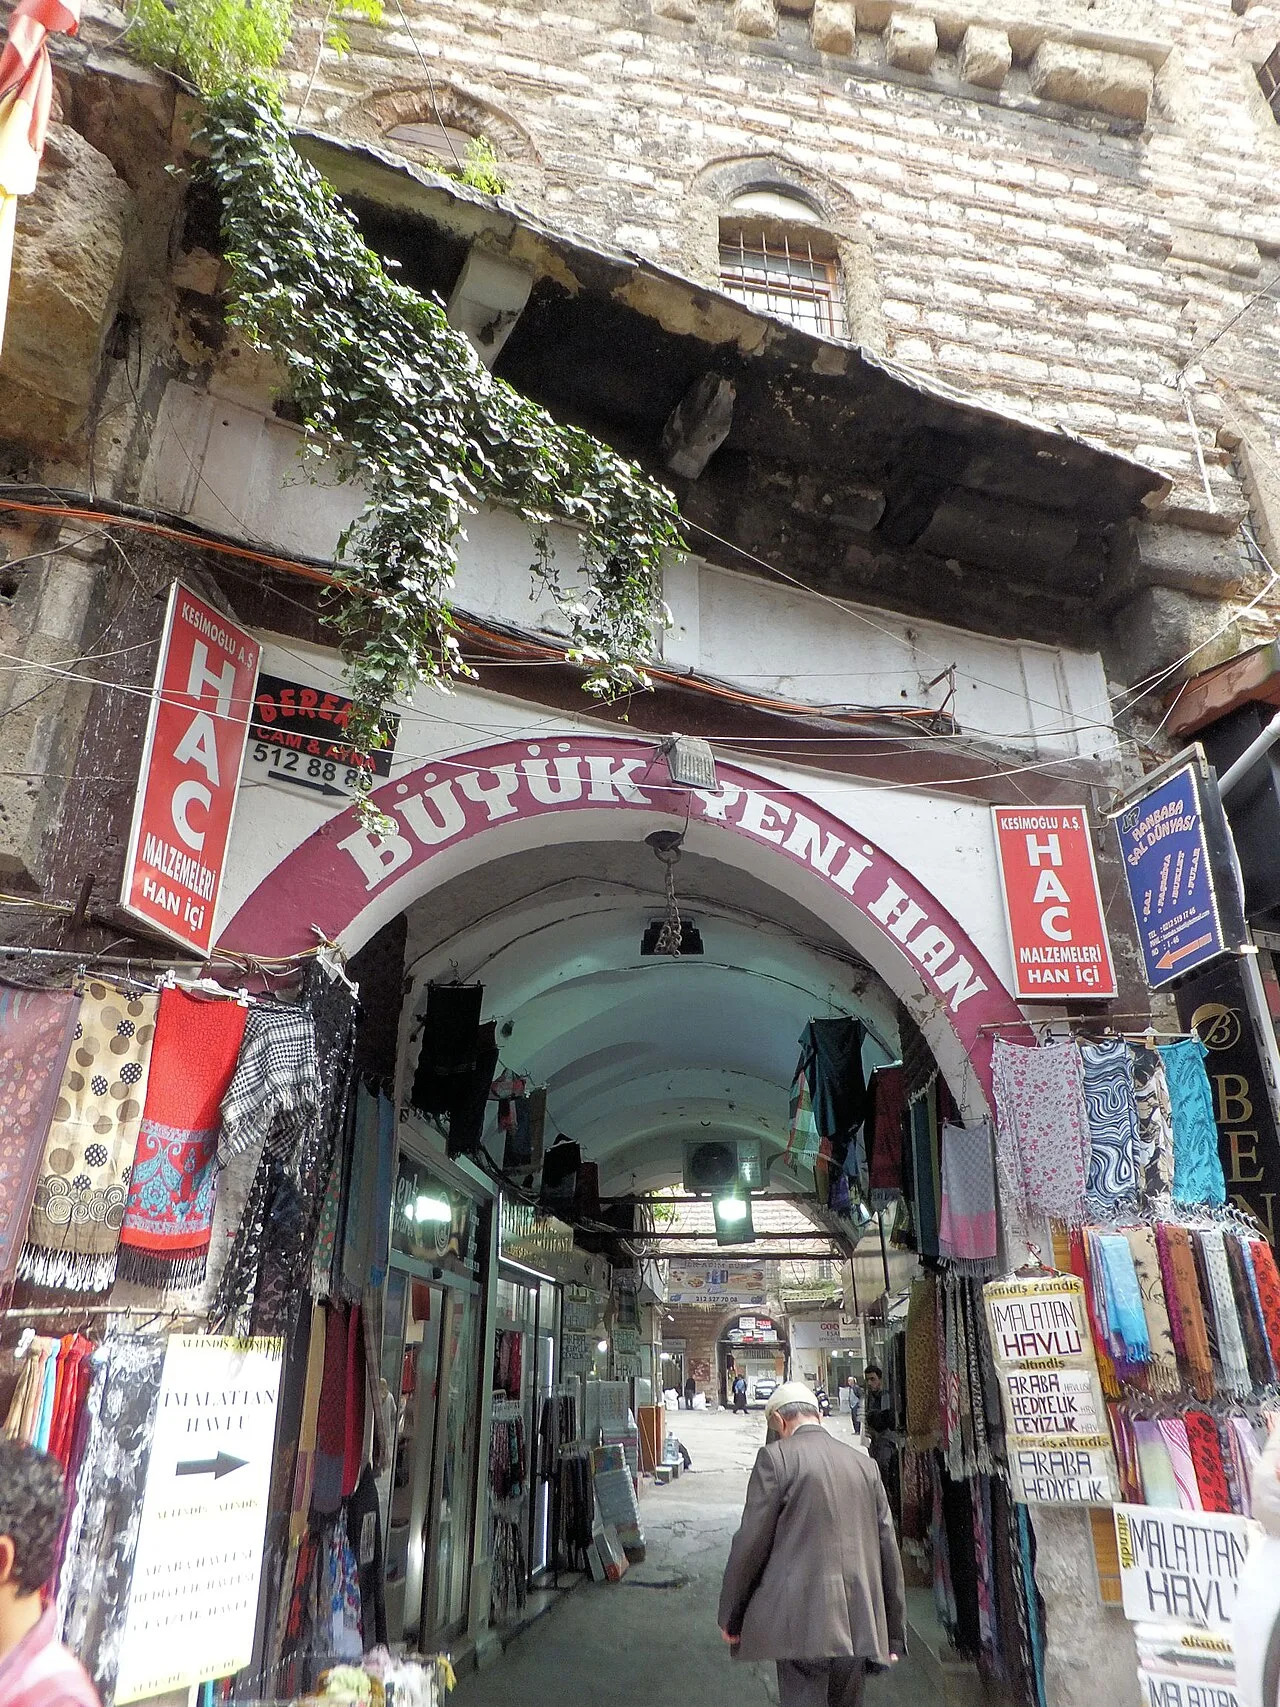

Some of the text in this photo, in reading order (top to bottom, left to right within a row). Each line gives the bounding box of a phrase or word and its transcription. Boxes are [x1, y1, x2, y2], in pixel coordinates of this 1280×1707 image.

[181, 602, 236, 655] KESİMOĞLU
[172, 639, 236, 851] HAC
[256, 727, 302, 749] CAM
[306, 739, 321, 755] &
[252, 743, 300, 772] 512
[306, 758, 337, 782] 88
[1000, 815, 1081, 832] KESİMOĞLU A.Ş.
[143, 832, 217, 902] MALZEMELERİ
[336, 742, 989, 1013] BÜYÜK YENİ HAN
[143, 877, 181, 917] HAN
[1025, 833, 1073, 942] HAC
[1019, 944, 1102, 964] MALZEMELERİ
[1027, 968, 1070, 984] HAN
[1003, 1330, 1082, 1357] HAVLU
[1007, 1373, 1061, 1395] ARABA
[1010, 1393, 1078, 1416] HEDİYELİK
[1018, 1450, 1093, 1477] ARABA
